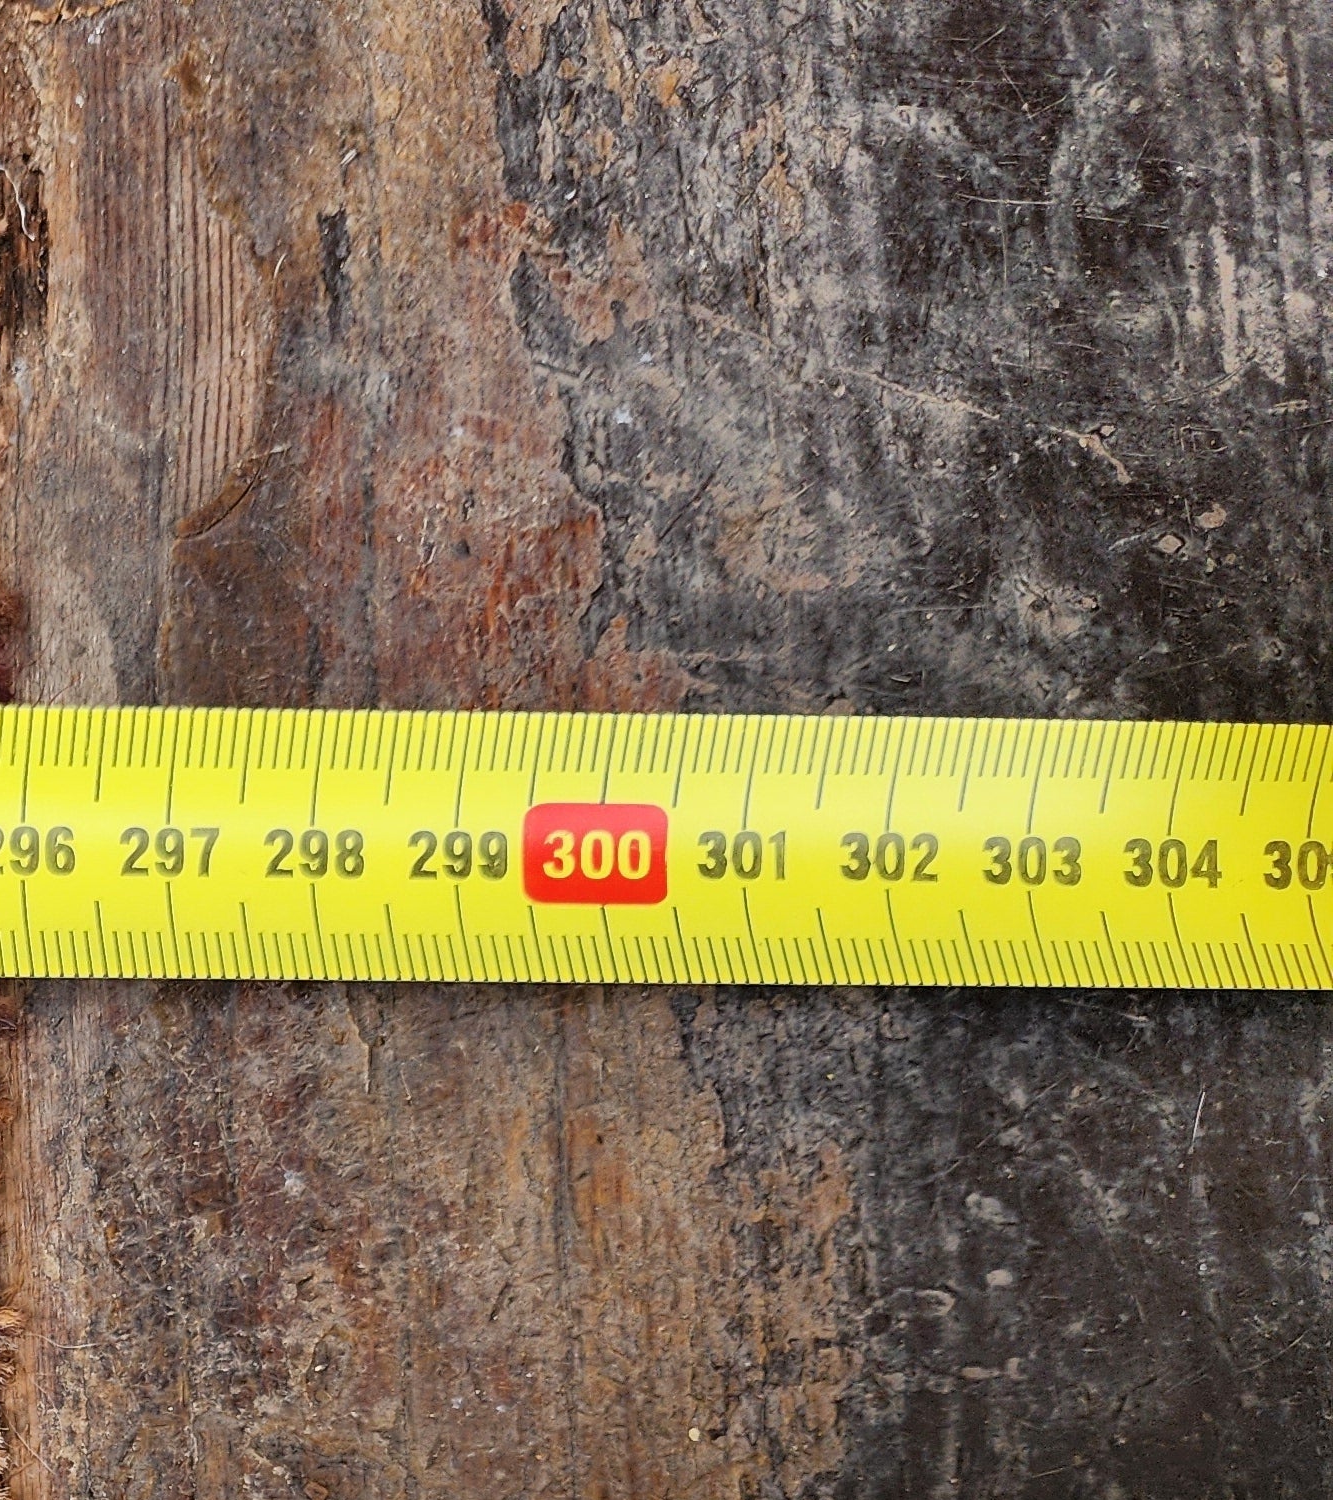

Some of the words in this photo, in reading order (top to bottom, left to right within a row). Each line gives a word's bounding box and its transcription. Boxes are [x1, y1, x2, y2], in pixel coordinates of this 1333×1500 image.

[121, 828, 219, 876] 297
[265, 829, 364, 877] 298
[409, 831, 507, 879] 299
[543, 829, 652, 880] 300
[698, 832, 785, 879] 301
[841, 833, 938, 882] 302
[983, 837, 1081, 886] 303
[1124, 838, 1222, 888] 304
[1263, 841, 1333, 890] 30
